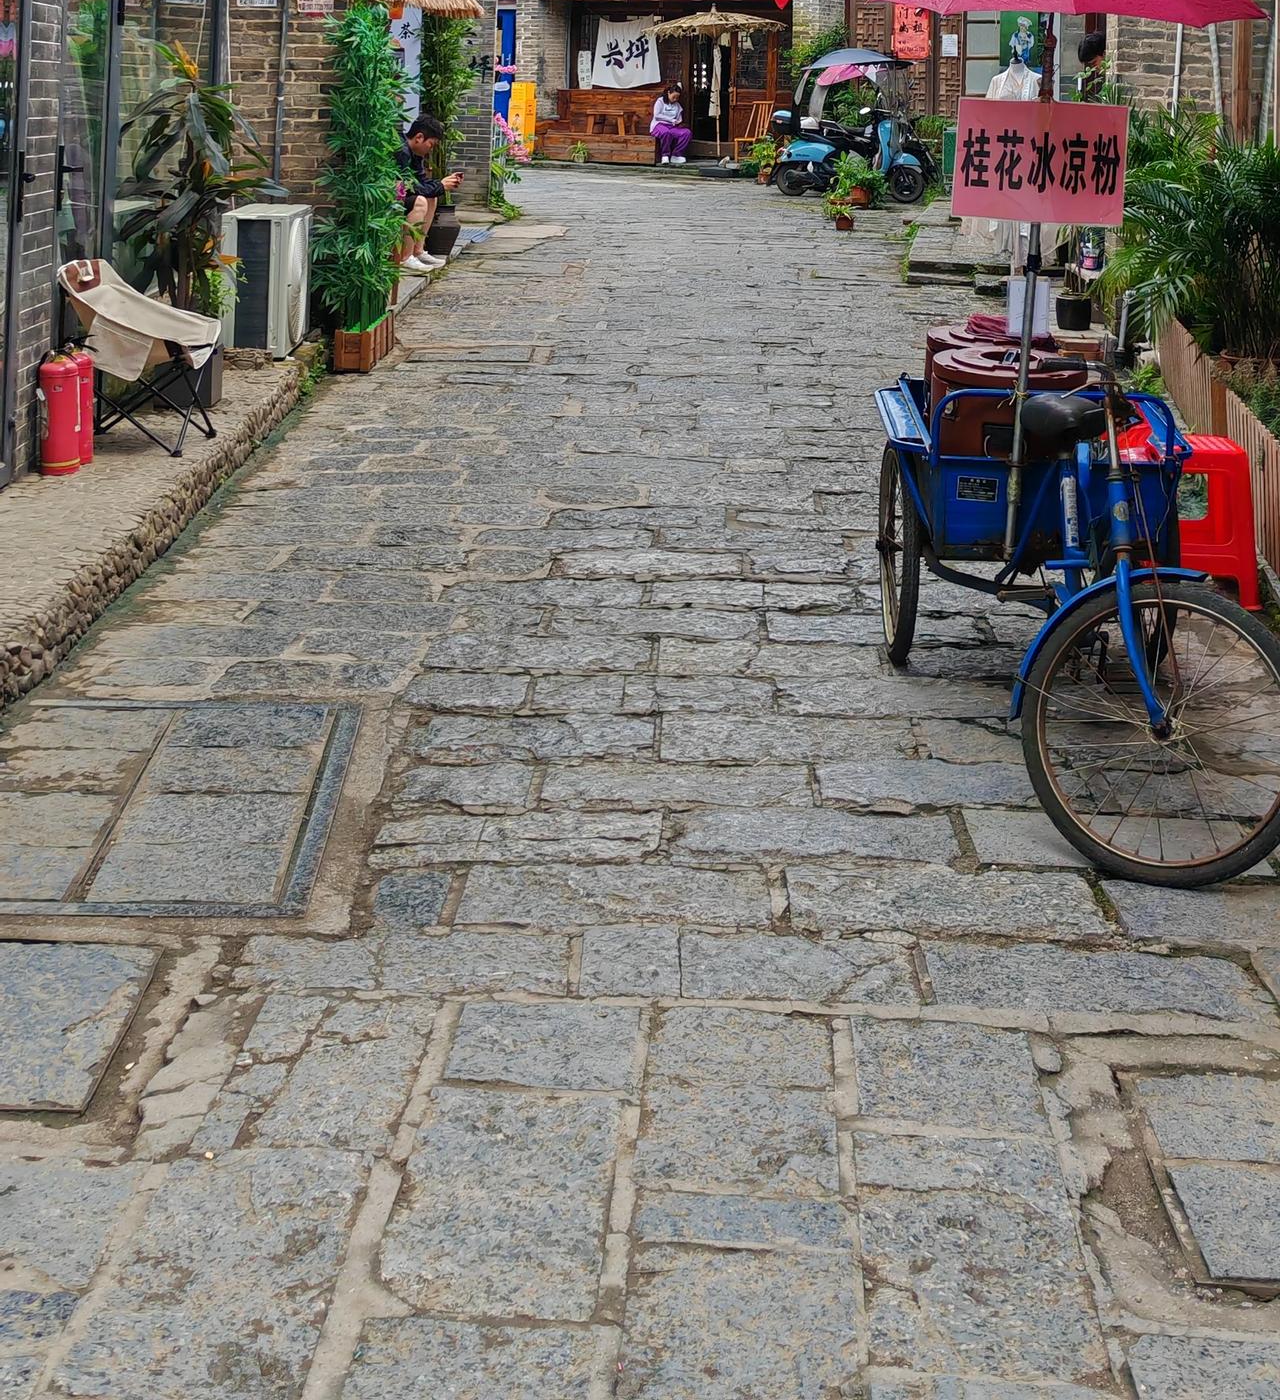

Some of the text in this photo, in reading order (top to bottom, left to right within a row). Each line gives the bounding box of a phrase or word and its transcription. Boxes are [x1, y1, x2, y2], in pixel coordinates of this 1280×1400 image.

[601, 33, 650, 70] 兴坪
[961, 128, 1121, 196] 桂花冰凉粉
